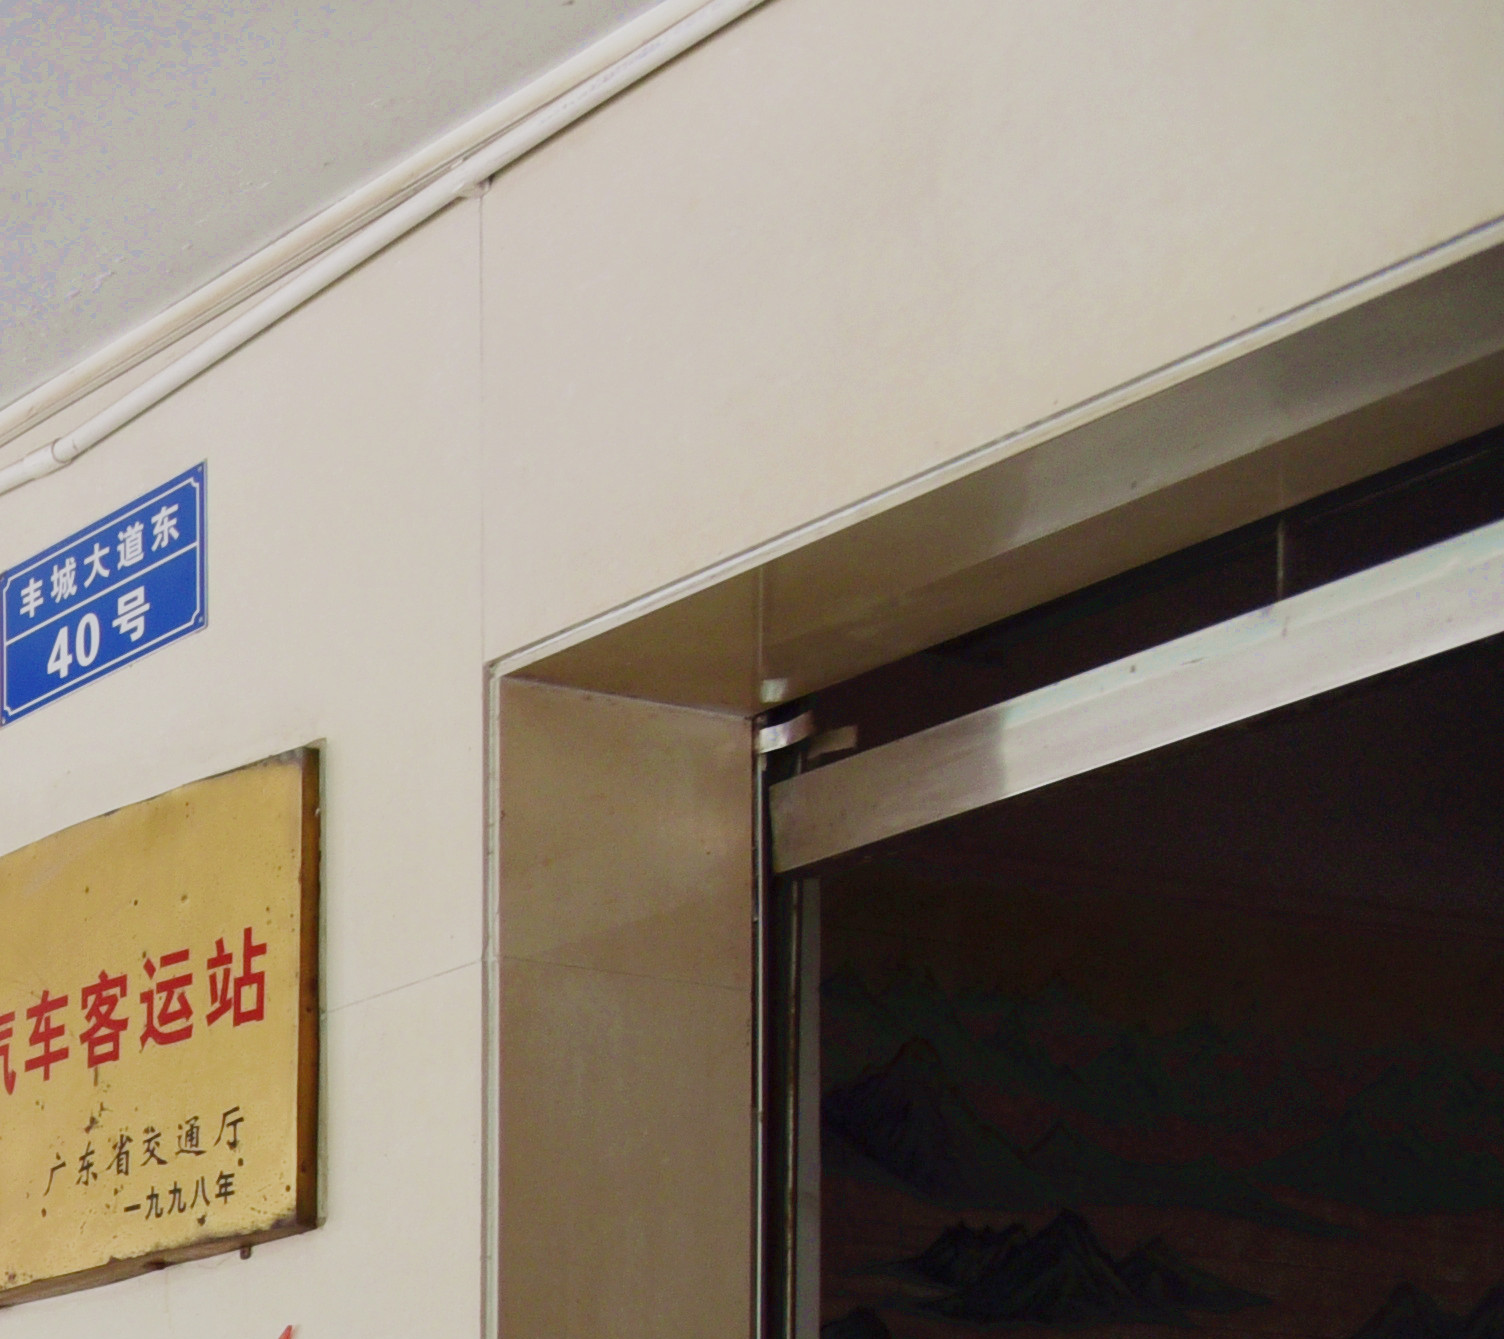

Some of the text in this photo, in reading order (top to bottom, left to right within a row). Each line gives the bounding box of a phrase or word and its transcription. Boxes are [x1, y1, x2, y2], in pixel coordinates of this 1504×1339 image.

[19, 503, 181, 621] 丰城大道东
[43, 1105, 245, 1197] 广东省交通厅
[123, 1169, 236, 1221] 一九九八年
